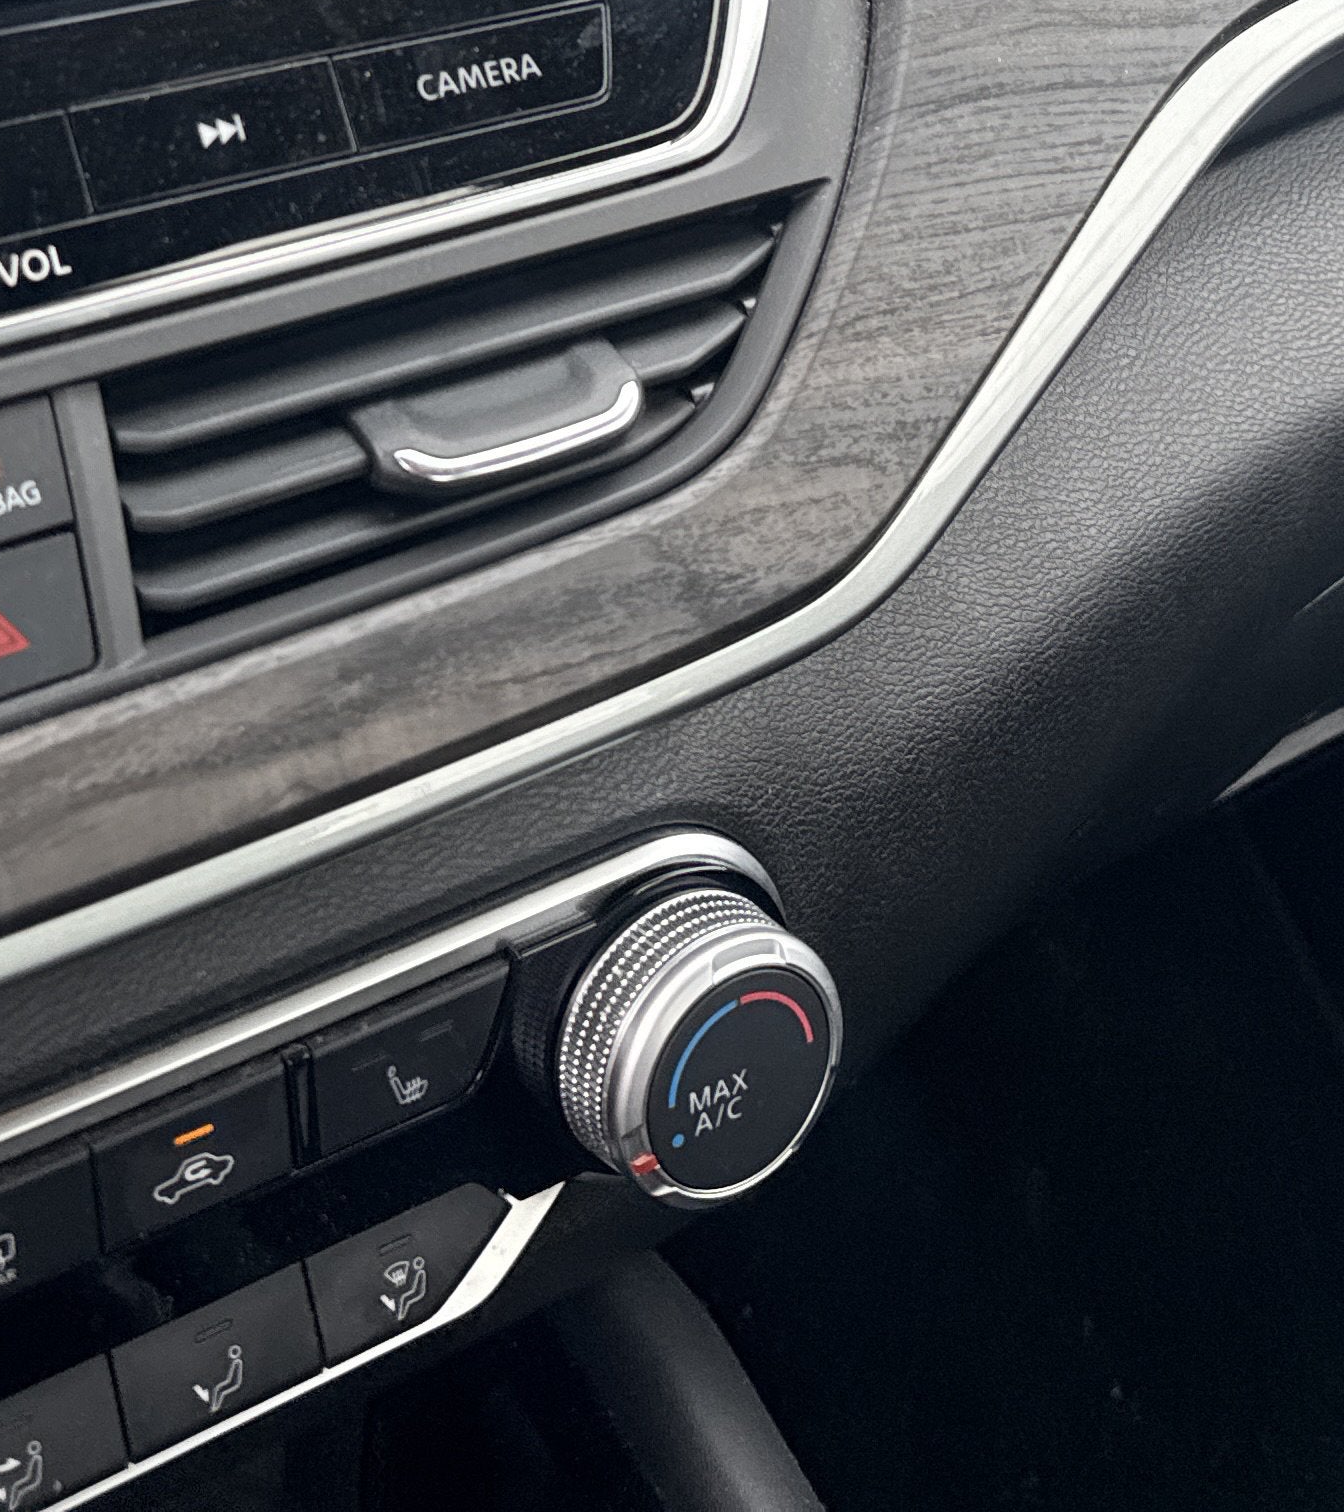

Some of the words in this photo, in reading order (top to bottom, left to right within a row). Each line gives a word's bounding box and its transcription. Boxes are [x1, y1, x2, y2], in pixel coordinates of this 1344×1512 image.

[416, 53, 542, 102] CAMERA
[688, 1068, 749, 1115] MAX
[694, 1095, 743, 1137] A/C
